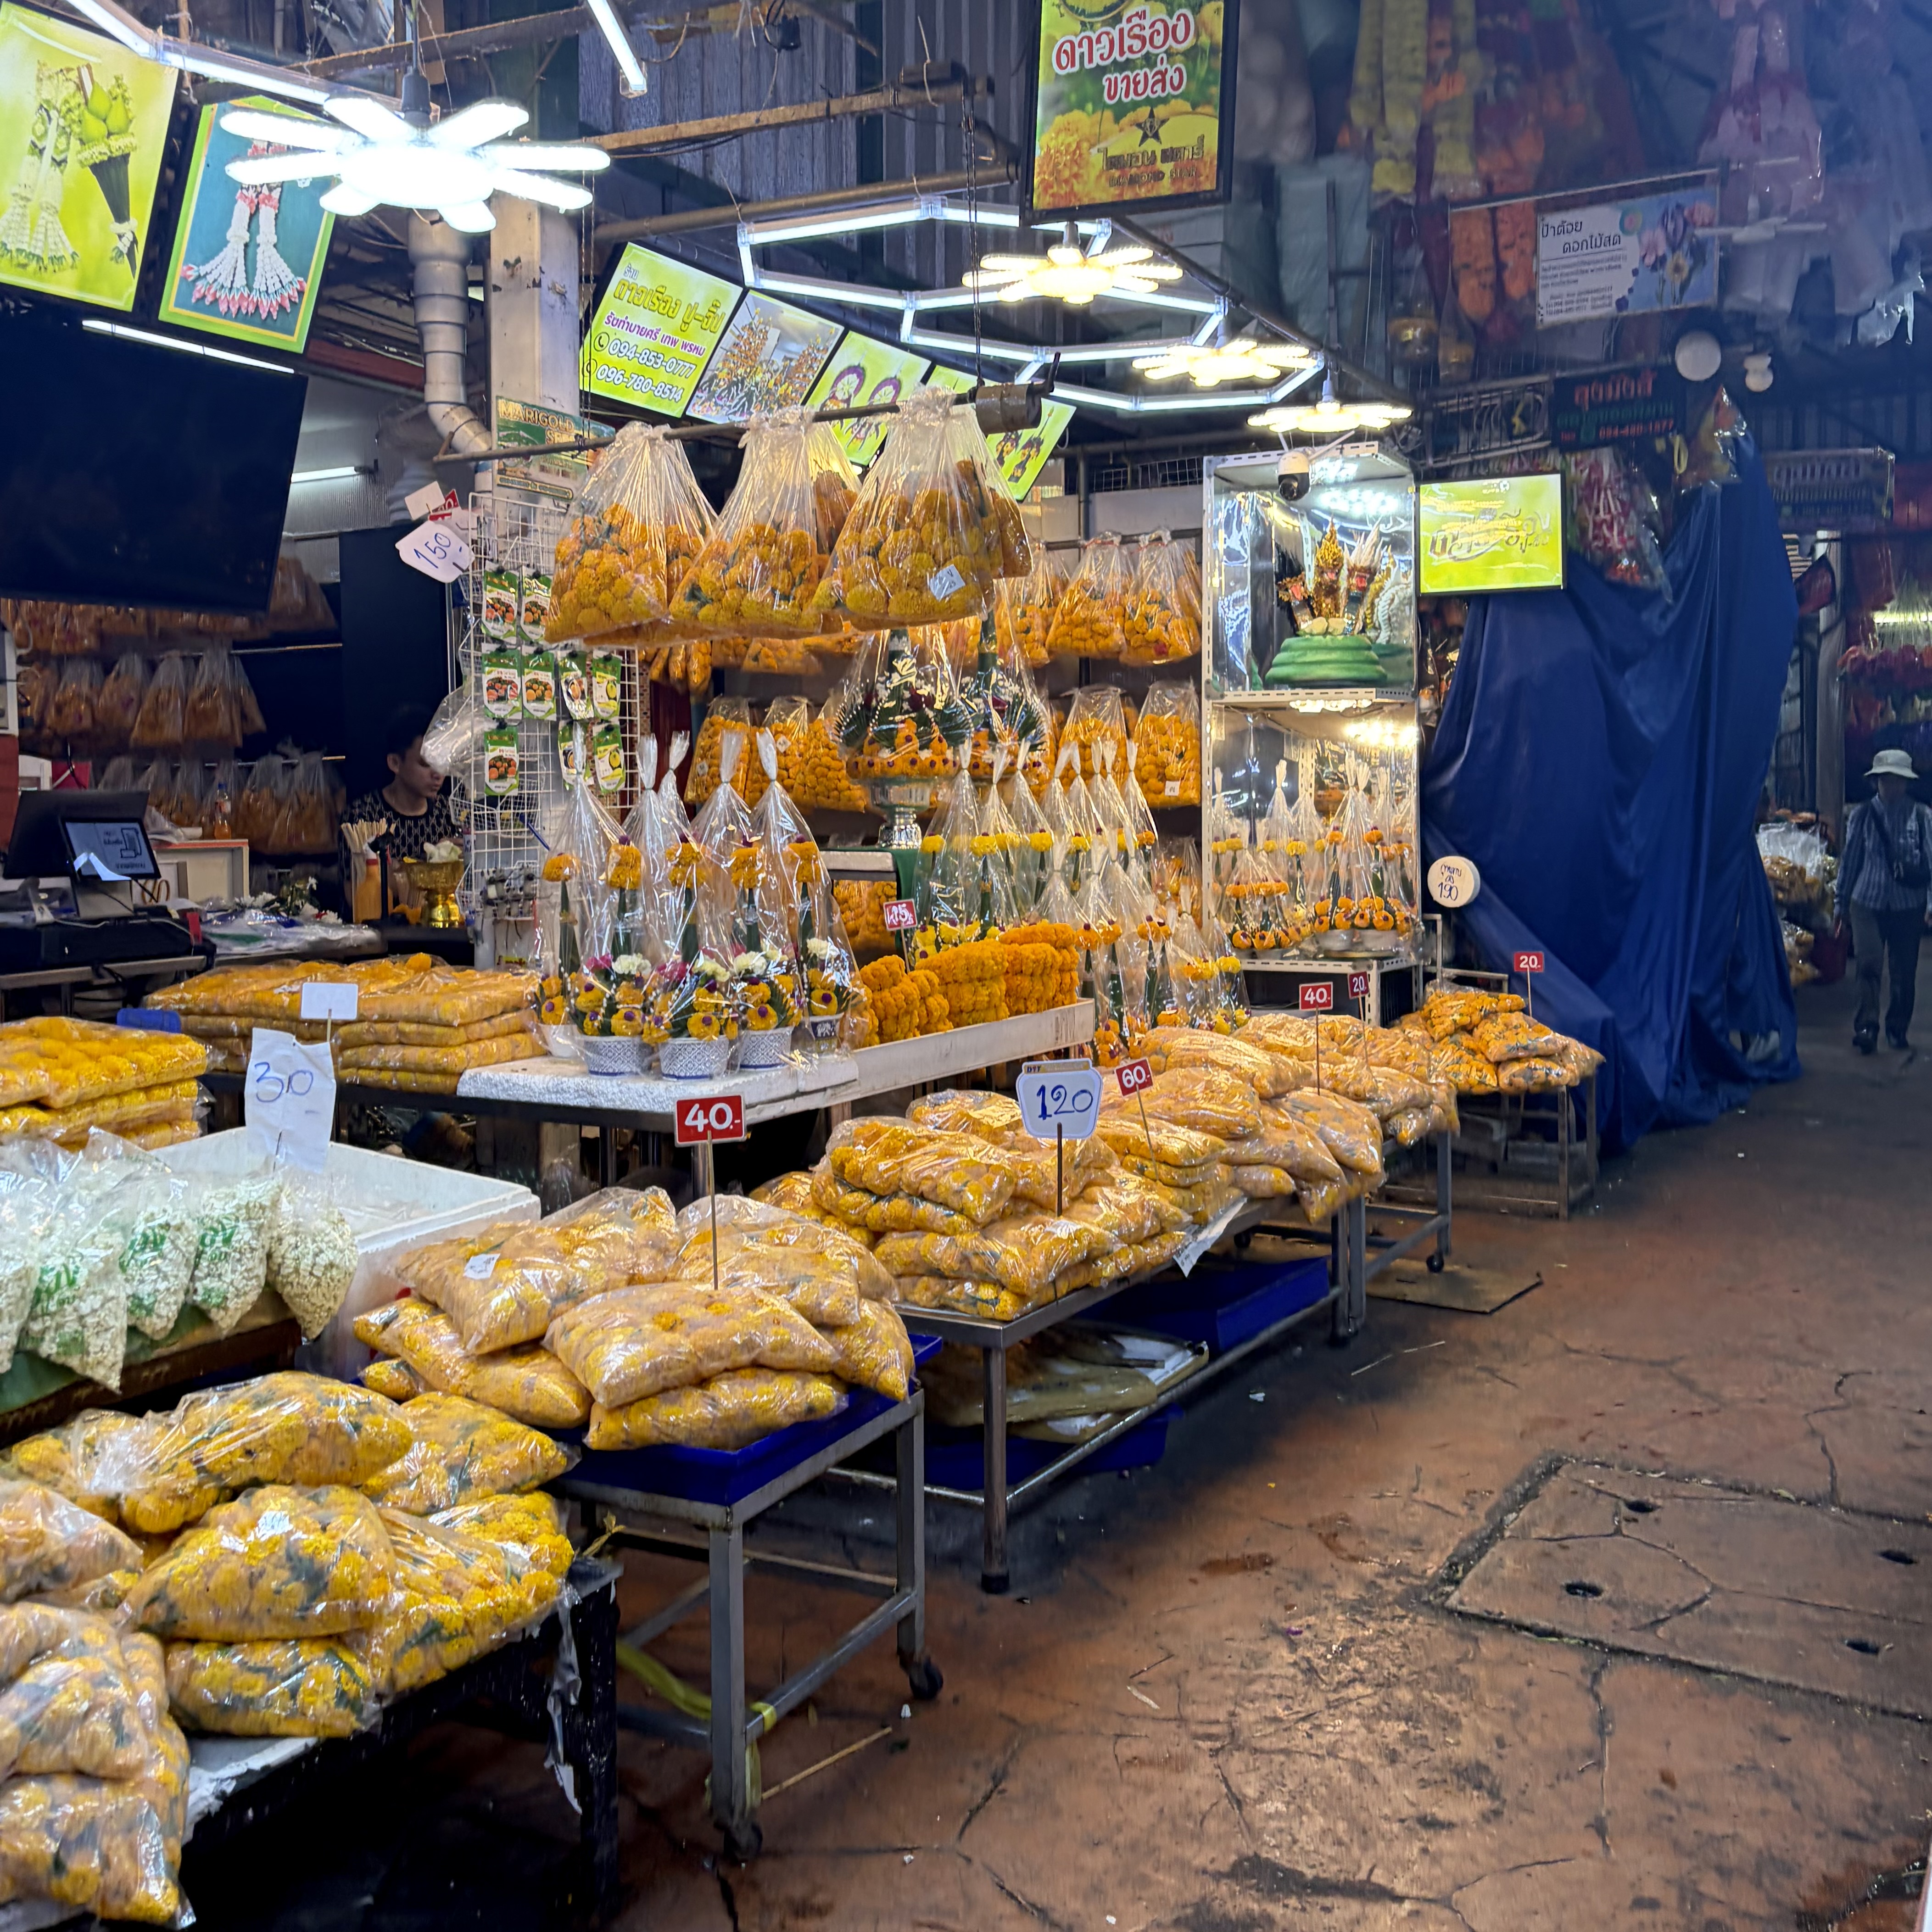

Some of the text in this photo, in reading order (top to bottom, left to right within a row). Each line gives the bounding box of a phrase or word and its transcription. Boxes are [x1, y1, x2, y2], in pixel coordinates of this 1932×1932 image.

[1055, 8, 1192, 72] ดาวเรือง
[1105, 56, 1184, 101] ขายส่ง
[1562, 233, 1621, 254] ดอกไม้สด
[623, 263, 639, 280] ร้าน
[604, 311, 706, 357] รับทำบายศรี เทพ พรหม
[608, 338, 697, 379] 094-853-0777
[596, 363, 685, 403] 096-780-8514
[497, 399, 575, 434] MARIGOLD
[413, 532, 451, 569] 150
[1438, 881, 1459, 901] 190
[254, 1061, 314, 1103] 30
[1036, 1084, 1094, 1121] 120
